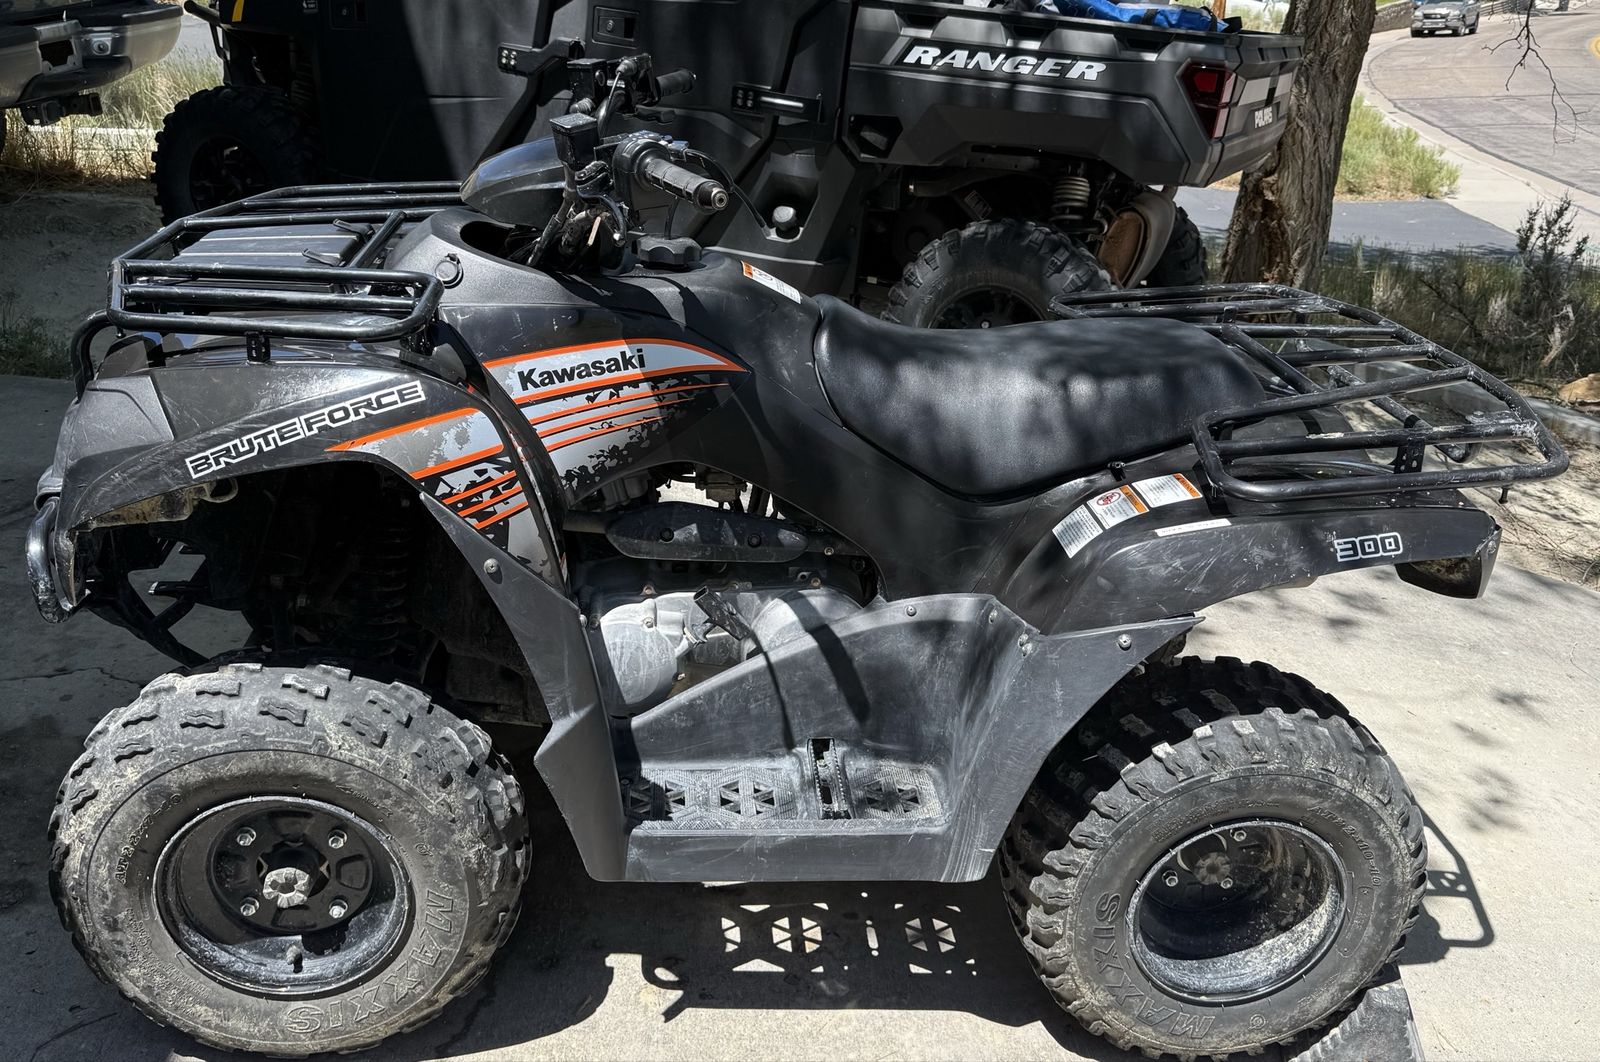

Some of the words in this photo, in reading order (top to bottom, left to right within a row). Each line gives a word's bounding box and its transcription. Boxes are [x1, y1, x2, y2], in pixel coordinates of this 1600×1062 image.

[903, 45, 1107, 81] RANGER
[518, 349, 646, 392] Kawasaki
[185, 415, 305, 479] BRUTE
[303, 380, 426, 438] FORCE
[1334, 532, 1404, 562] 300
[284, 890, 455, 1034] MAXXIS
[1094, 891, 1216, 1039] MAXXIS
